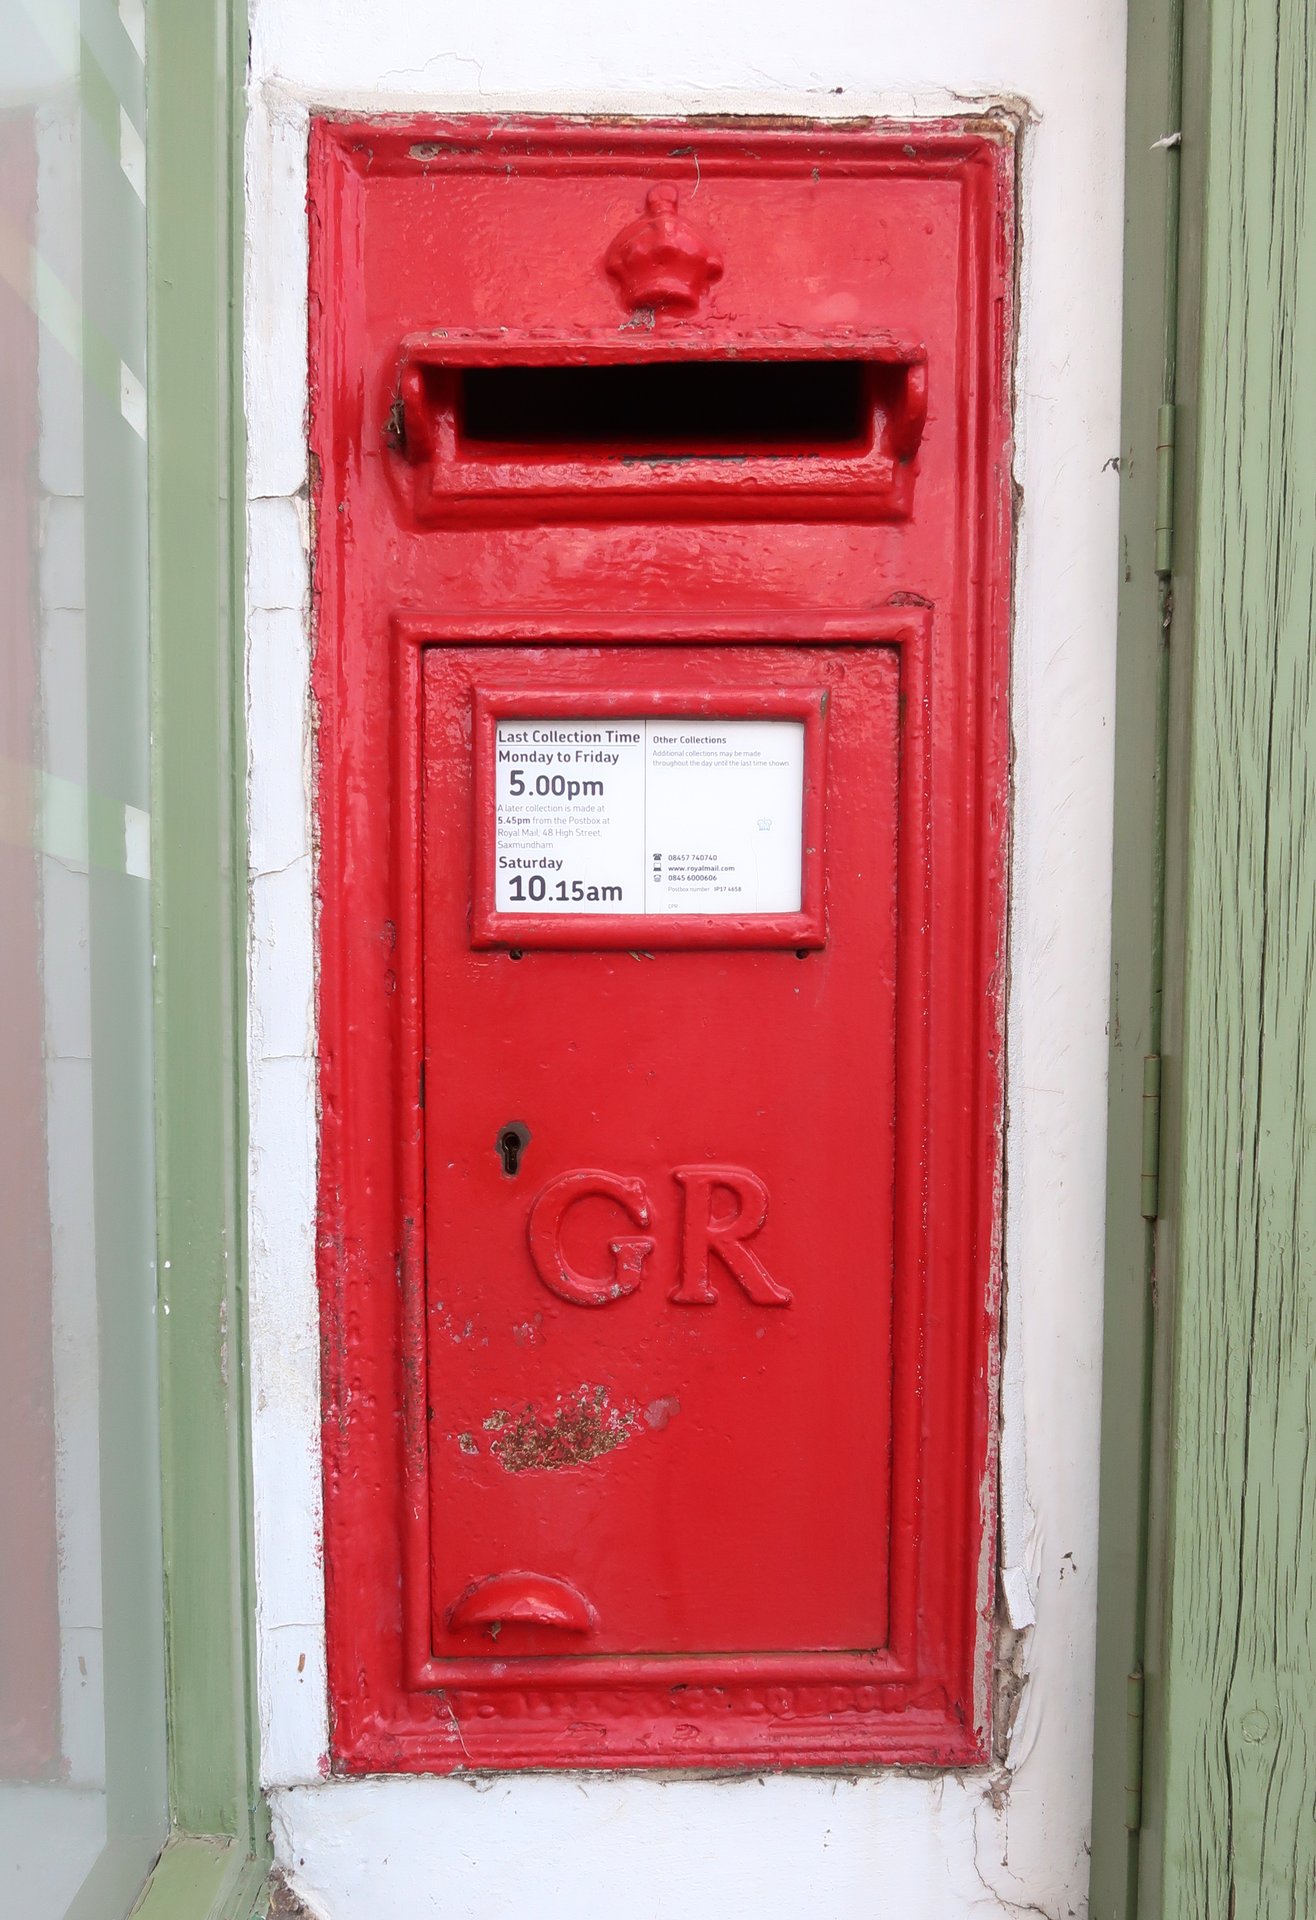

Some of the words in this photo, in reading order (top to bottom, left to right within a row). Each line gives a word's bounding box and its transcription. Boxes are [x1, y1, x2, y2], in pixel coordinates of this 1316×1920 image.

[498, 730, 528, 743] Last
[532, 730, 601, 743] Collection
[605, 730, 640, 743] Time
[653, 736, 677, 744] Other
[680, 736, 727, 744] Collections
[499, 750, 553, 765] Monday
[557, 752, 571, 763] to
[575, 750, 619, 765] Friday
[653, 760, 688, 768] throughout
[700, 760, 713, 768] day
[509, 769, 604, 801] 5.00pm
[497, 804, 504, 812] A
[505, 804, 523, 812] later
[525, 804, 563, 812] collection
[565, 804, 571, 812] is
[573, 804, 596, 812] made
[597, 804, 605, 812] at
[498, 816, 531, 826] 5.45pm
[532, 816, 552, 825] from
[553, 816, 567, 825] the
[569, 816, 601, 825] Postbox
[602, 816, 610, 825] at
[498, 829, 520, 838] Royal
[543, 829, 554, 837] 48
[555, 829, 574, 838] High
[498, 841, 554, 849] Saxmundham
[499, 856, 564, 871] Saturday
[668, 865, 735, 873] www.royalmail.com
[509, 875, 623, 901] 10.15am
[525, 1164, 794, 1307] GR
